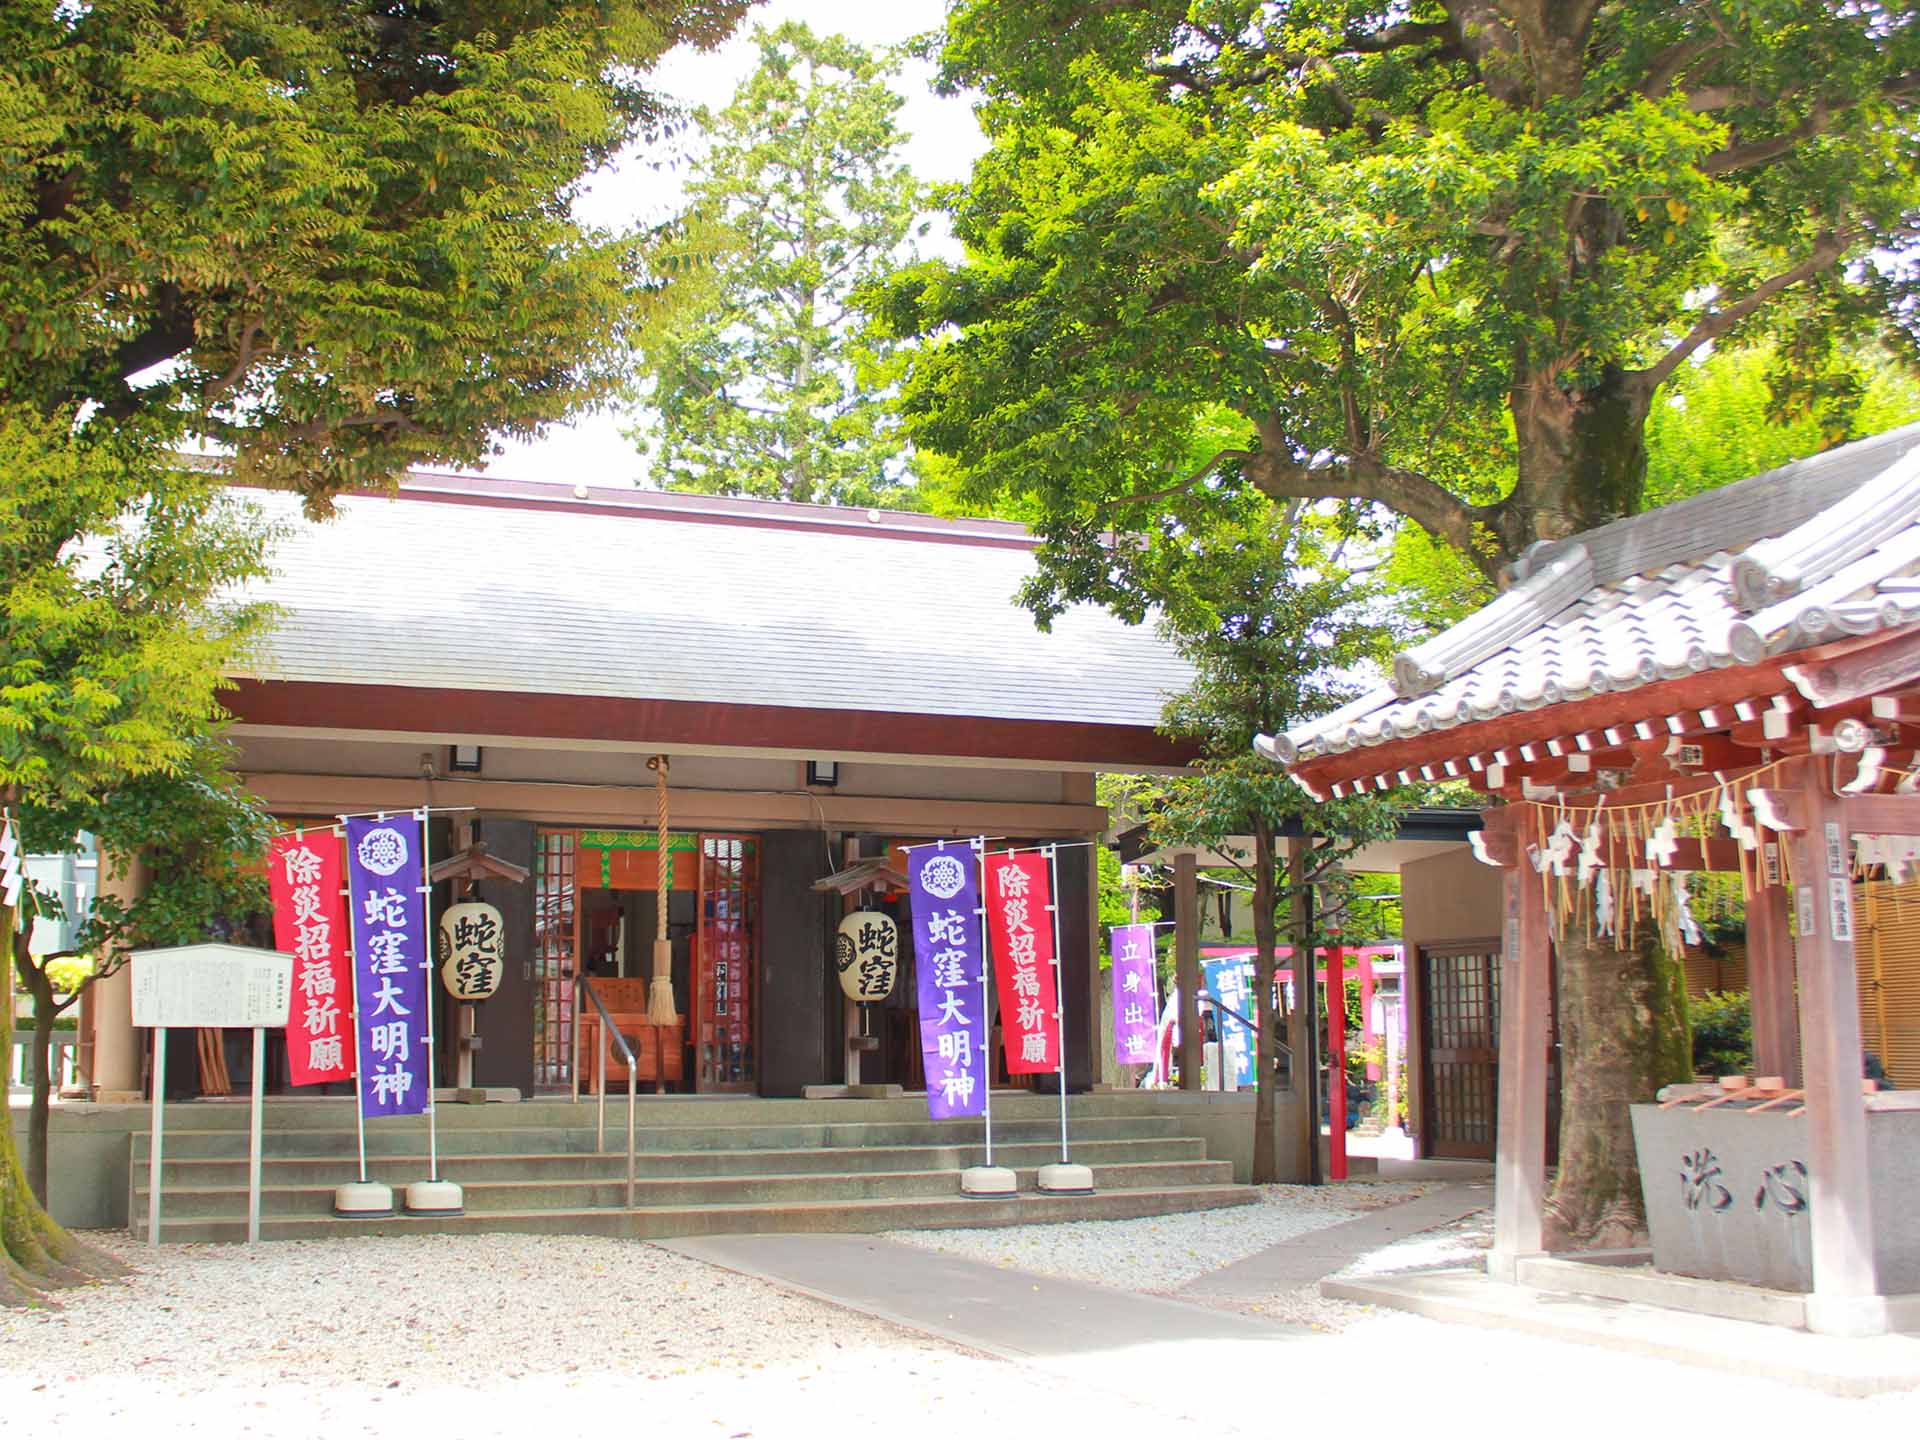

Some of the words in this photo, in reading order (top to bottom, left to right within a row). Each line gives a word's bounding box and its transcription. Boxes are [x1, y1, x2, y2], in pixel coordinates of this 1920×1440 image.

[283, 846, 344, 1071] 除災招福祈願
[364, 887, 413, 1105] 蛇窪大明神
[455, 913, 496, 996] 蛇窪
[858, 920, 895, 996] 蛇窪
[928, 909, 975, 1108] 蛇窪大明神
[997, 864, 1048, 1064] 除災招福祈願
[1120, 940, 1147, 1056] 立身出世
[1680, 1148, 1808, 1213] 洗心
